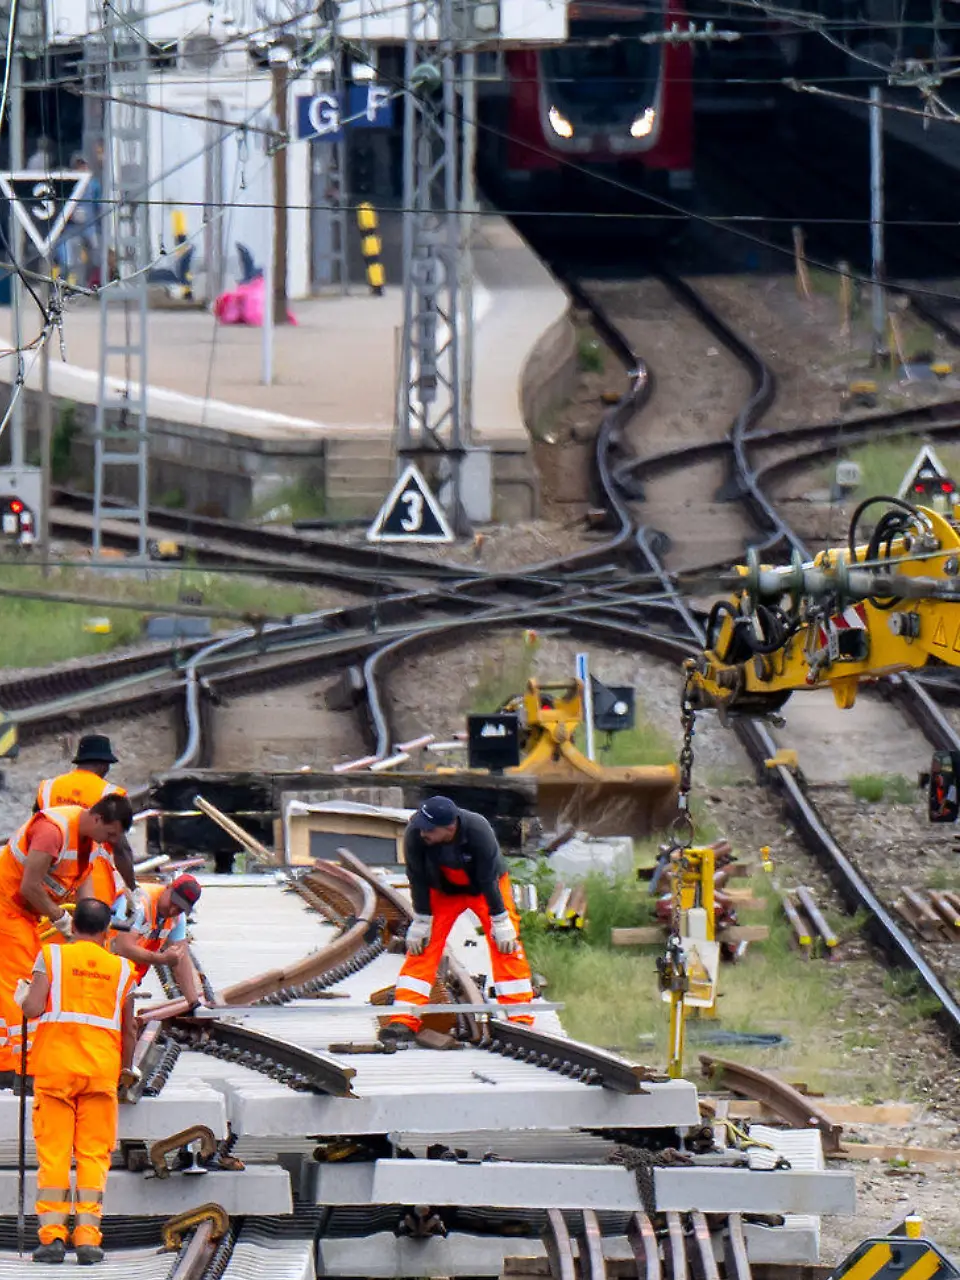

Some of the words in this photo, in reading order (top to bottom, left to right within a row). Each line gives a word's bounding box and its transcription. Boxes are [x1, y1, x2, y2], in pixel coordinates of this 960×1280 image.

[309, 94, 339, 132] G
[367, 83, 390, 121] F
[32, 182, 55, 220] 3
[401, 490, 423, 531] 3
